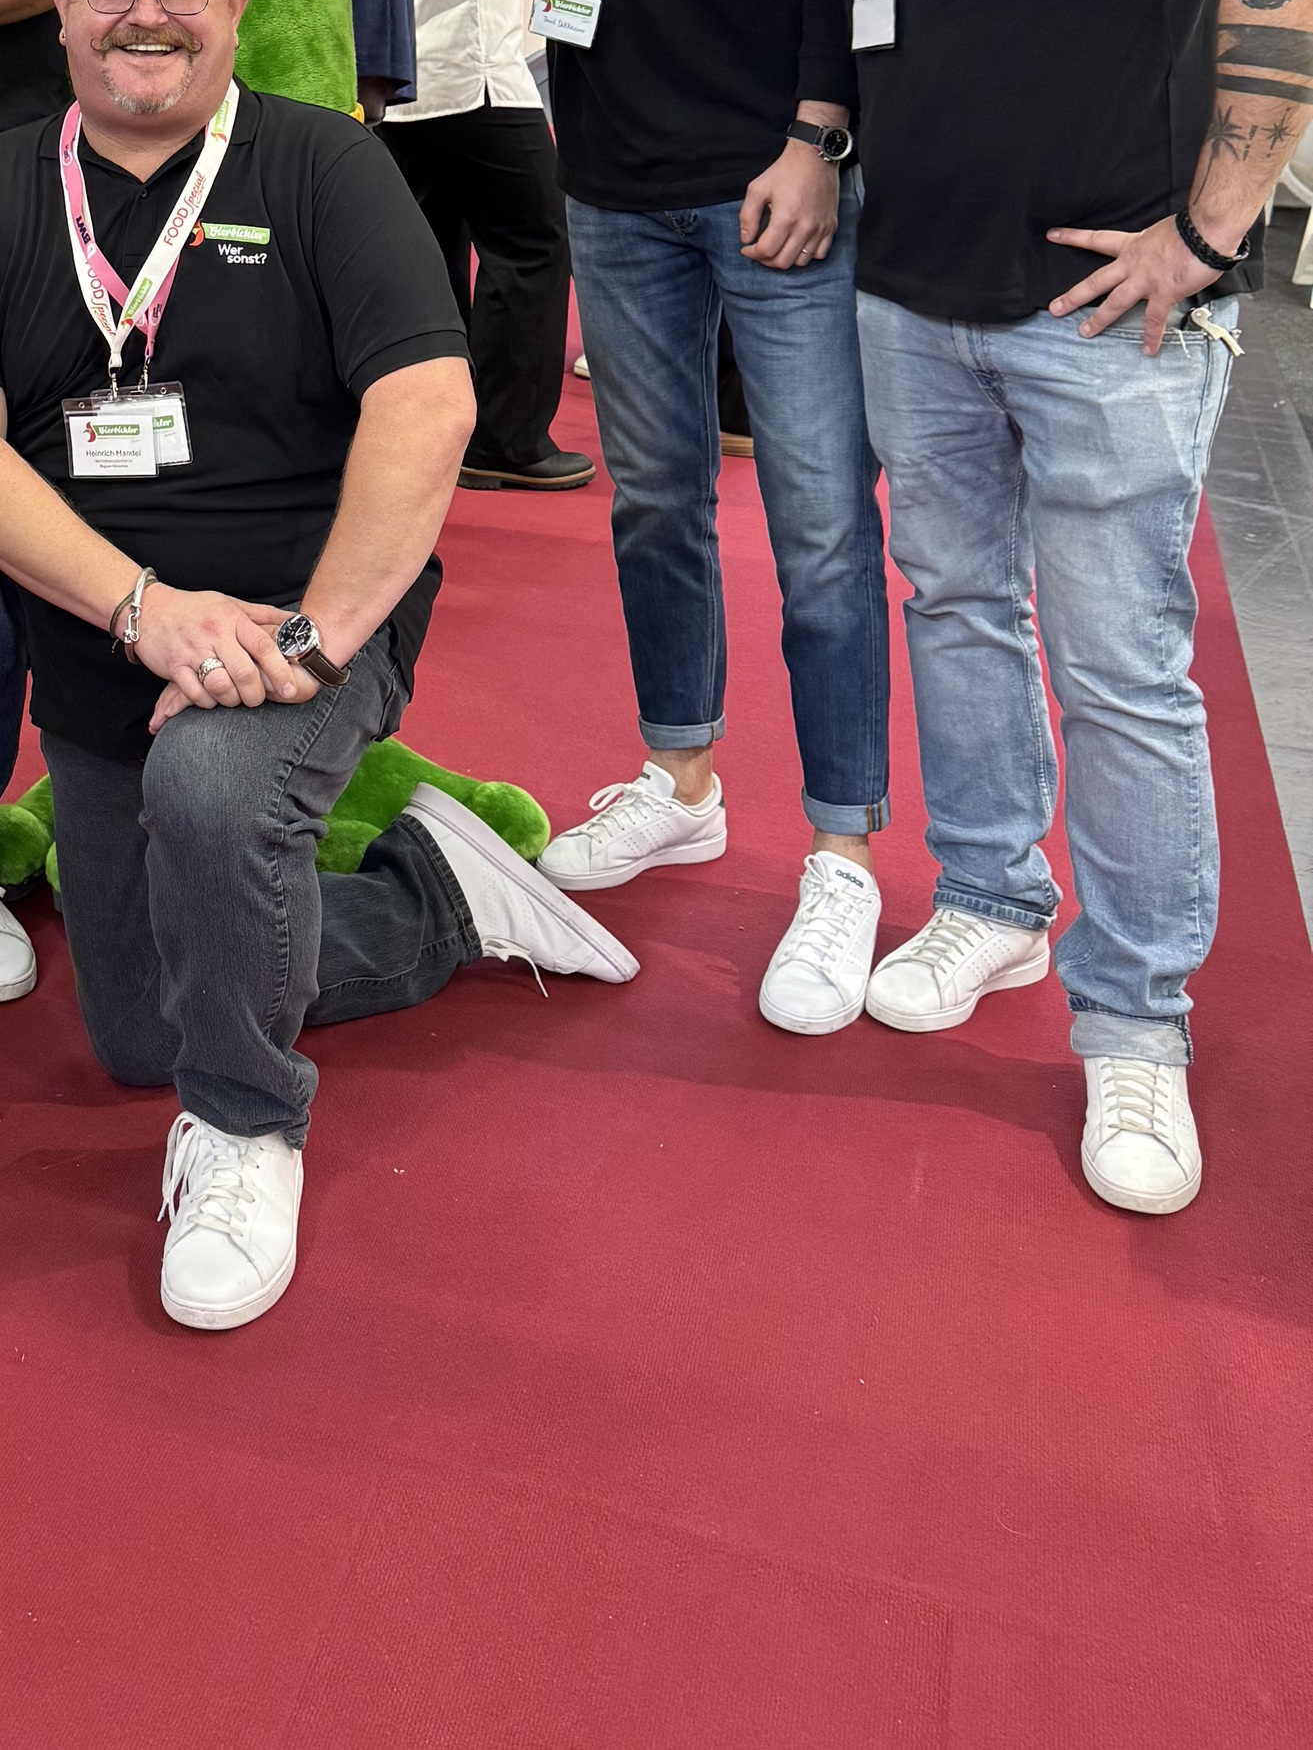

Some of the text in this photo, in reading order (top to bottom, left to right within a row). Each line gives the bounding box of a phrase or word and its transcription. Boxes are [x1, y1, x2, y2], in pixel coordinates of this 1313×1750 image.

[163, 170, 207, 247] FOOD Special
[209, 225, 266, 241] Bierbichler
[218, 243, 244, 255] Wer
[227, 253, 268, 265] sonst?
[85, 262, 105, 299] OOD
[835, 869, 864, 888] adidas
